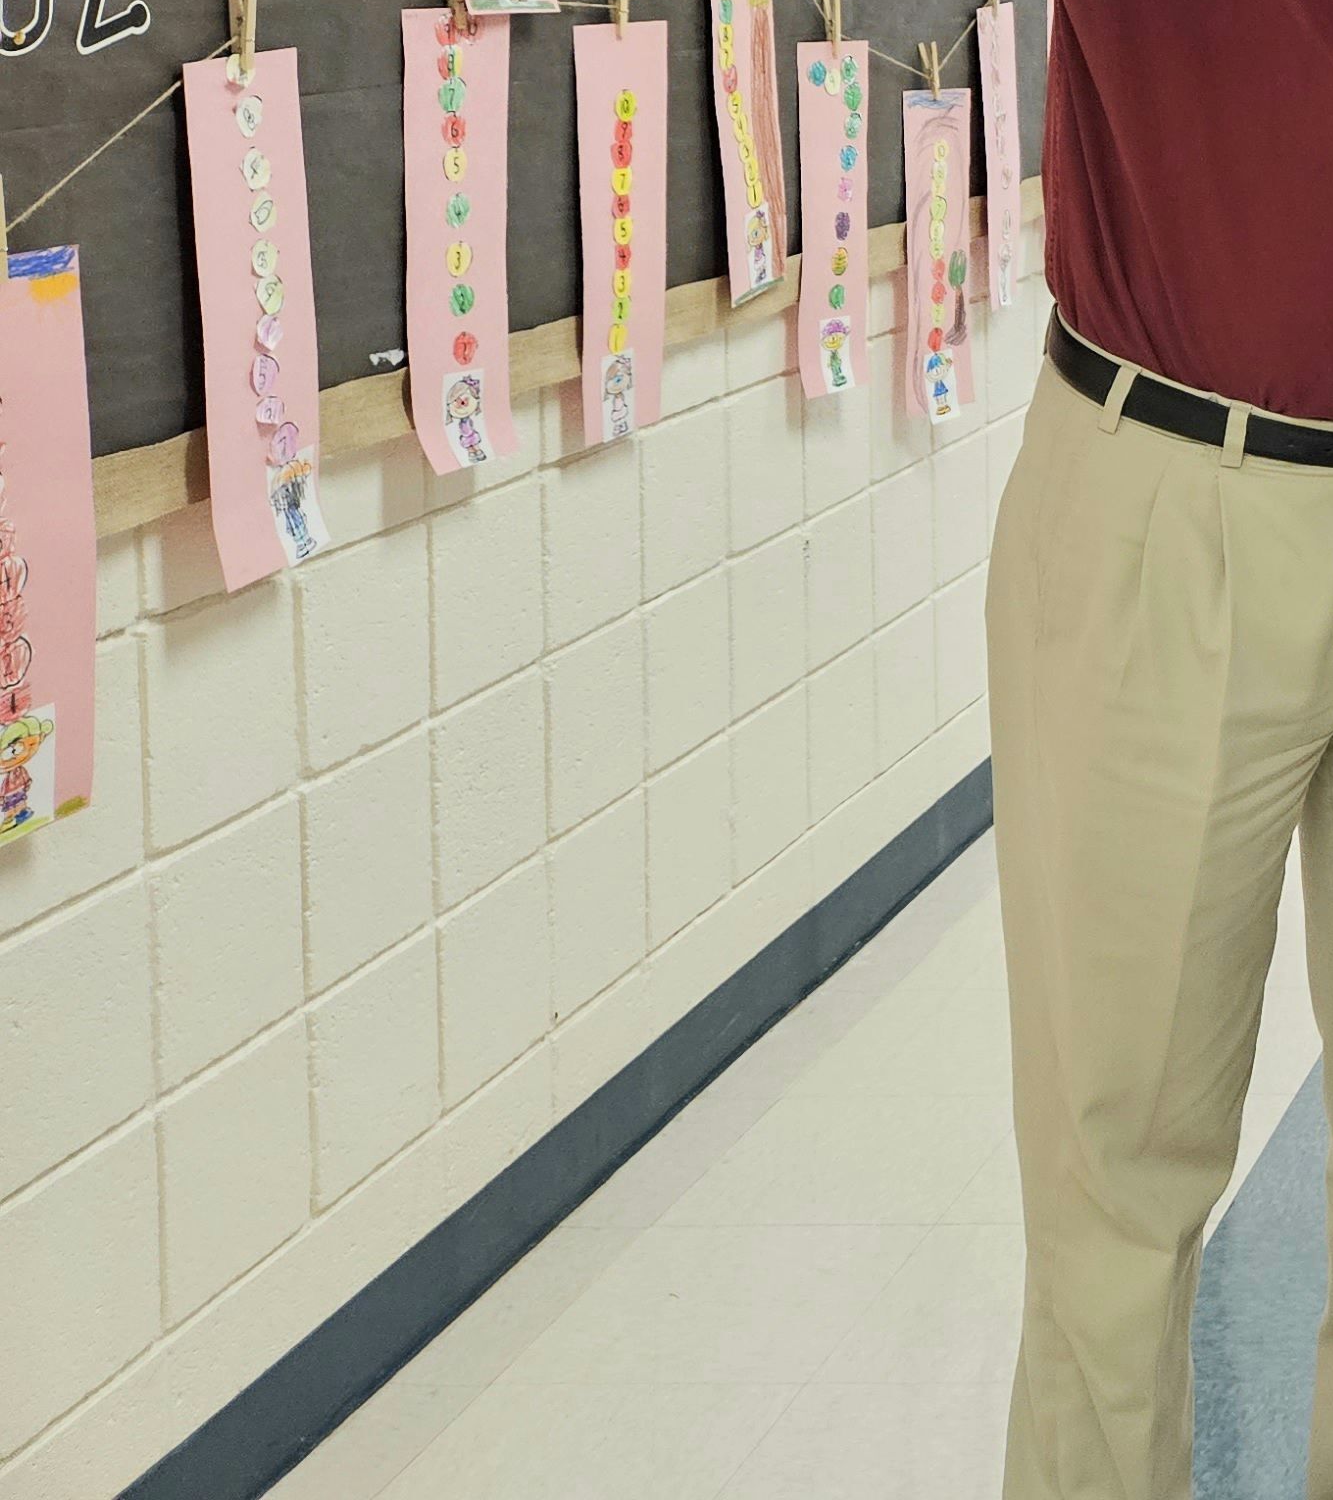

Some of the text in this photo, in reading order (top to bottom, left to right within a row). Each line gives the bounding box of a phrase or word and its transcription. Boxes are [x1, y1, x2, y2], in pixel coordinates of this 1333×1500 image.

[448, 87, 455, 107] 7
[450, 119, 459, 138] 6
[621, 121, 629, 139] 9
[453, 156, 460, 175] 5
[619, 222, 627, 238] 5
[617, 275, 626, 293] 3
